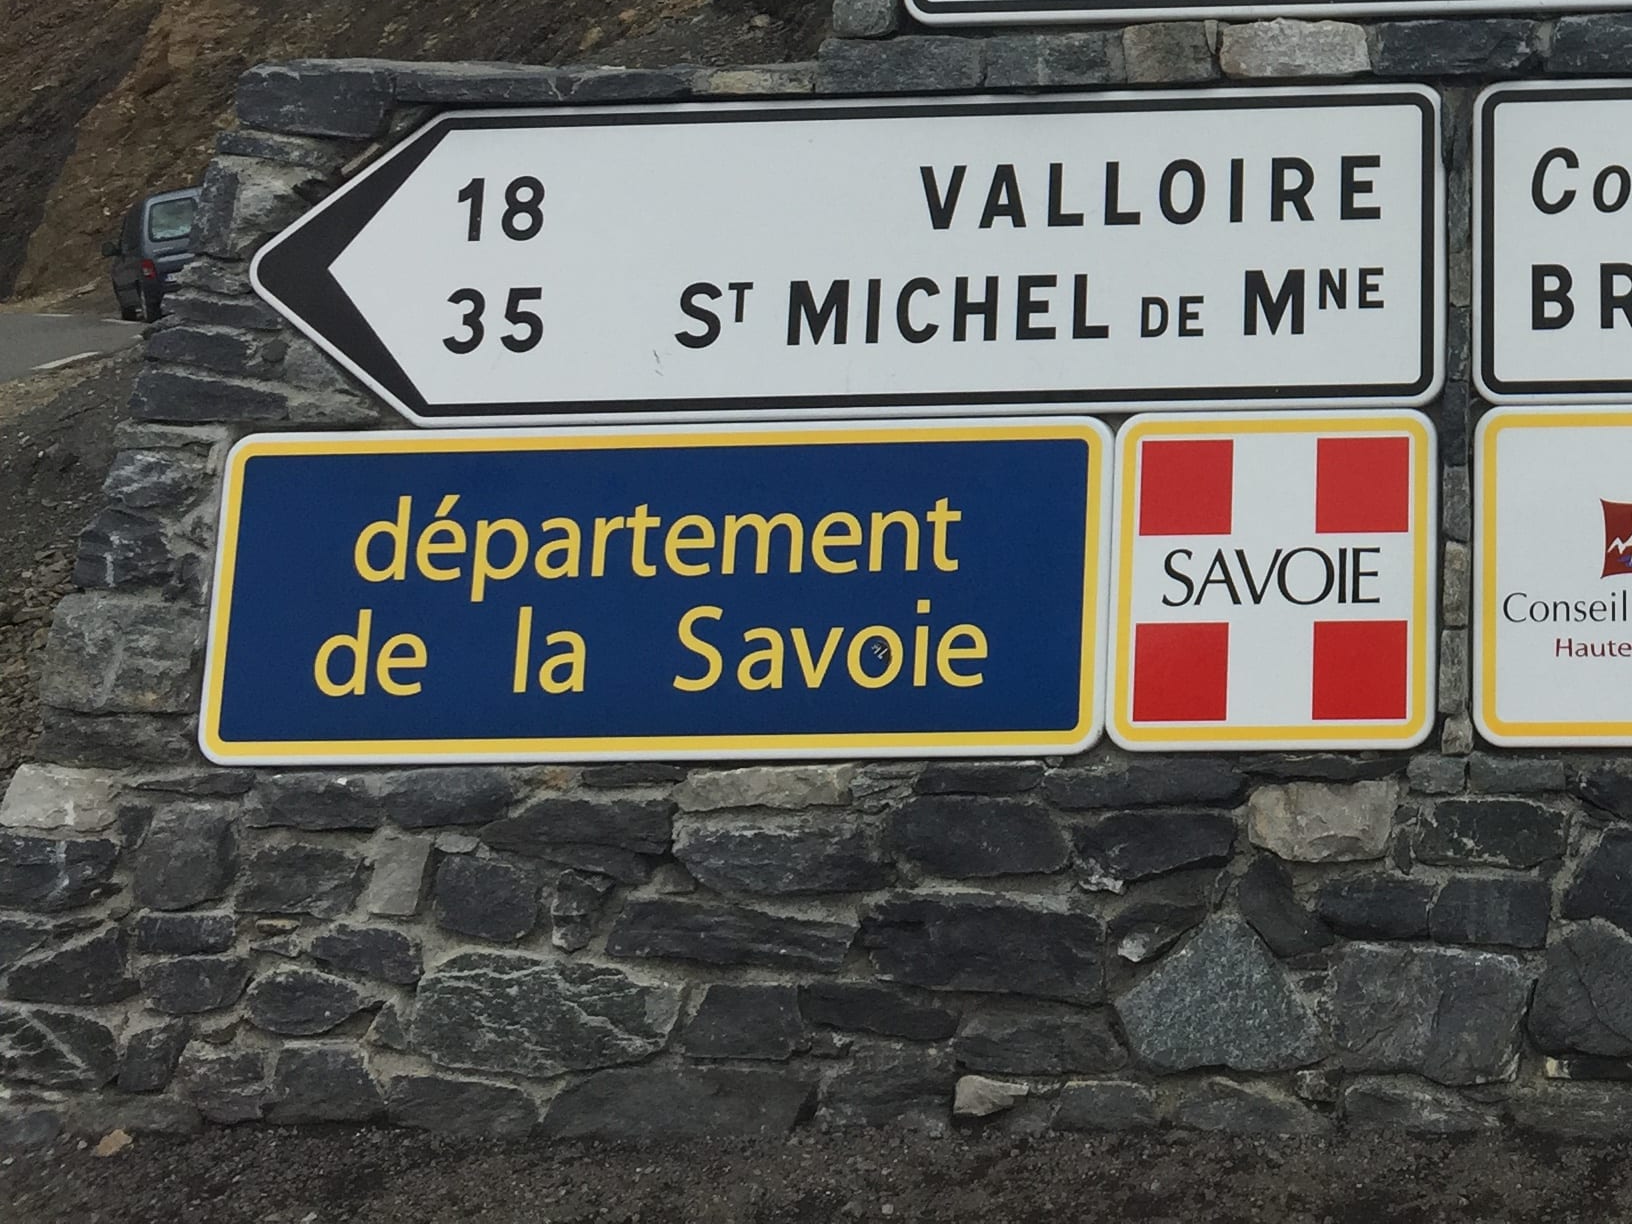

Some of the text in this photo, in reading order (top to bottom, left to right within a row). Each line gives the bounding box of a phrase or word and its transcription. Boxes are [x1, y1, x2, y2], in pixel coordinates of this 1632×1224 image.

[457, 154, 1381, 242] 18 VALLOIRE
[442, 287, 544, 355] 35
[786, 273, 1110, 346] MICHEL
[1140, 295, 1204, 338] DE
[354, 494, 961, 602] département
[1161, 547, 1381, 607] SAVOIE
[314, 599, 988, 697] de la Savoie
[1502, 589, 1627, 623] Conseil
